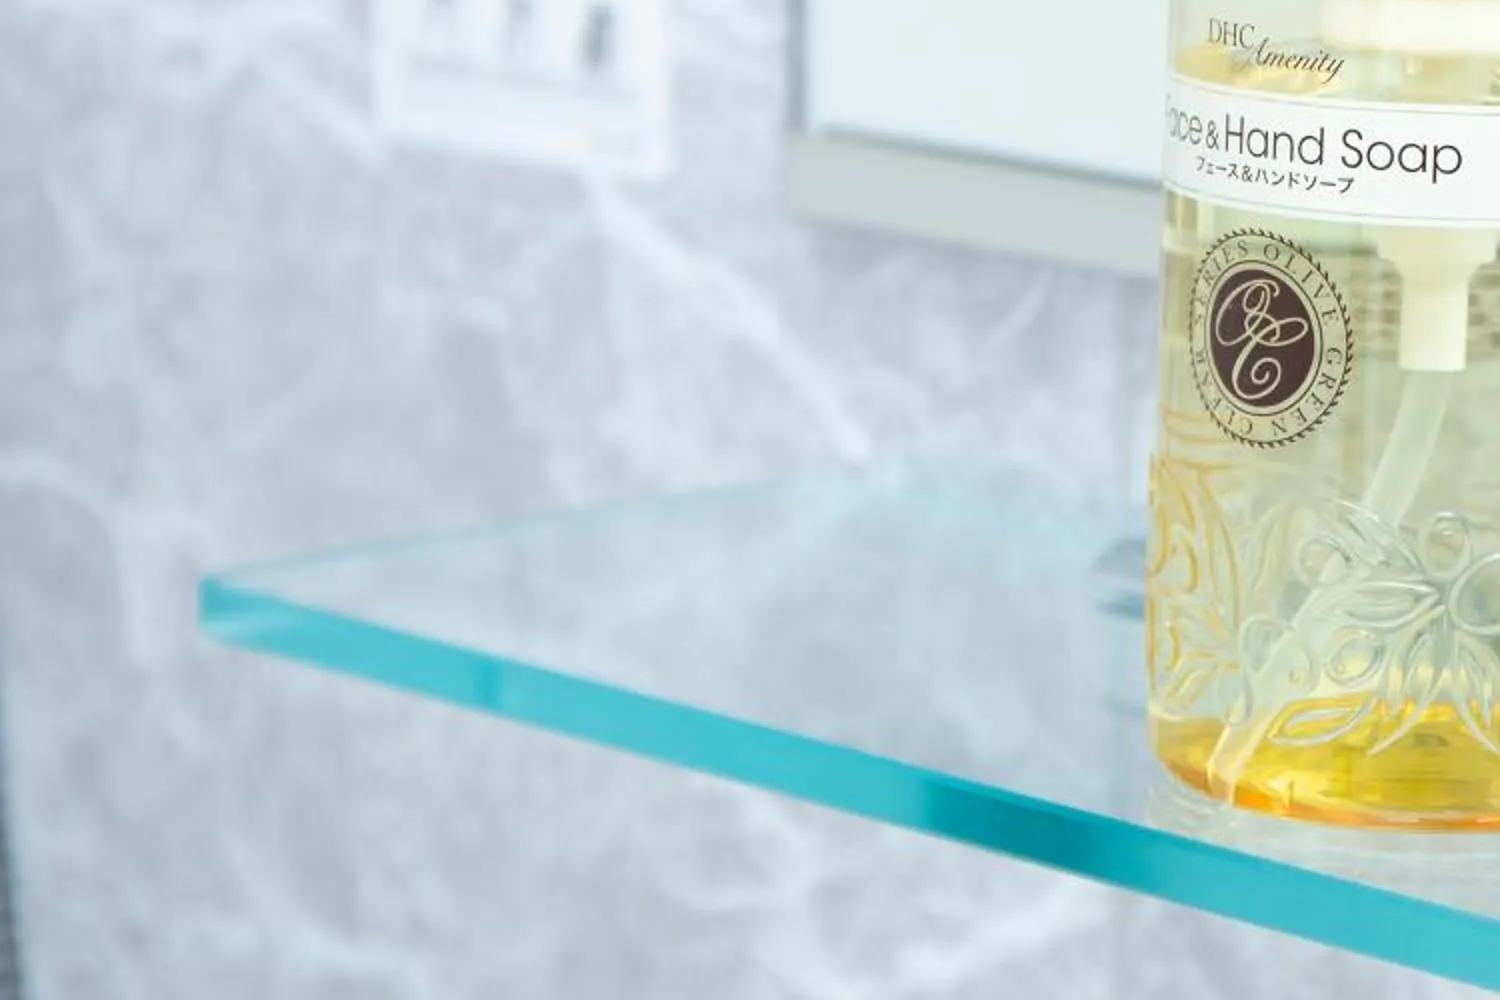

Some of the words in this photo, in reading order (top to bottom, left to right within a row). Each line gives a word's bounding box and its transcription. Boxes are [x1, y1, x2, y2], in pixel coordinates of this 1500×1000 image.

[1209, 17, 1255, 49] DHC
[1252, 37, 1345, 85] Amenity
[1341, 128, 1463, 185] Soap
[1263, 243, 1340, 327] OLIVE
[1271, 346, 1342, 436] GREEN
